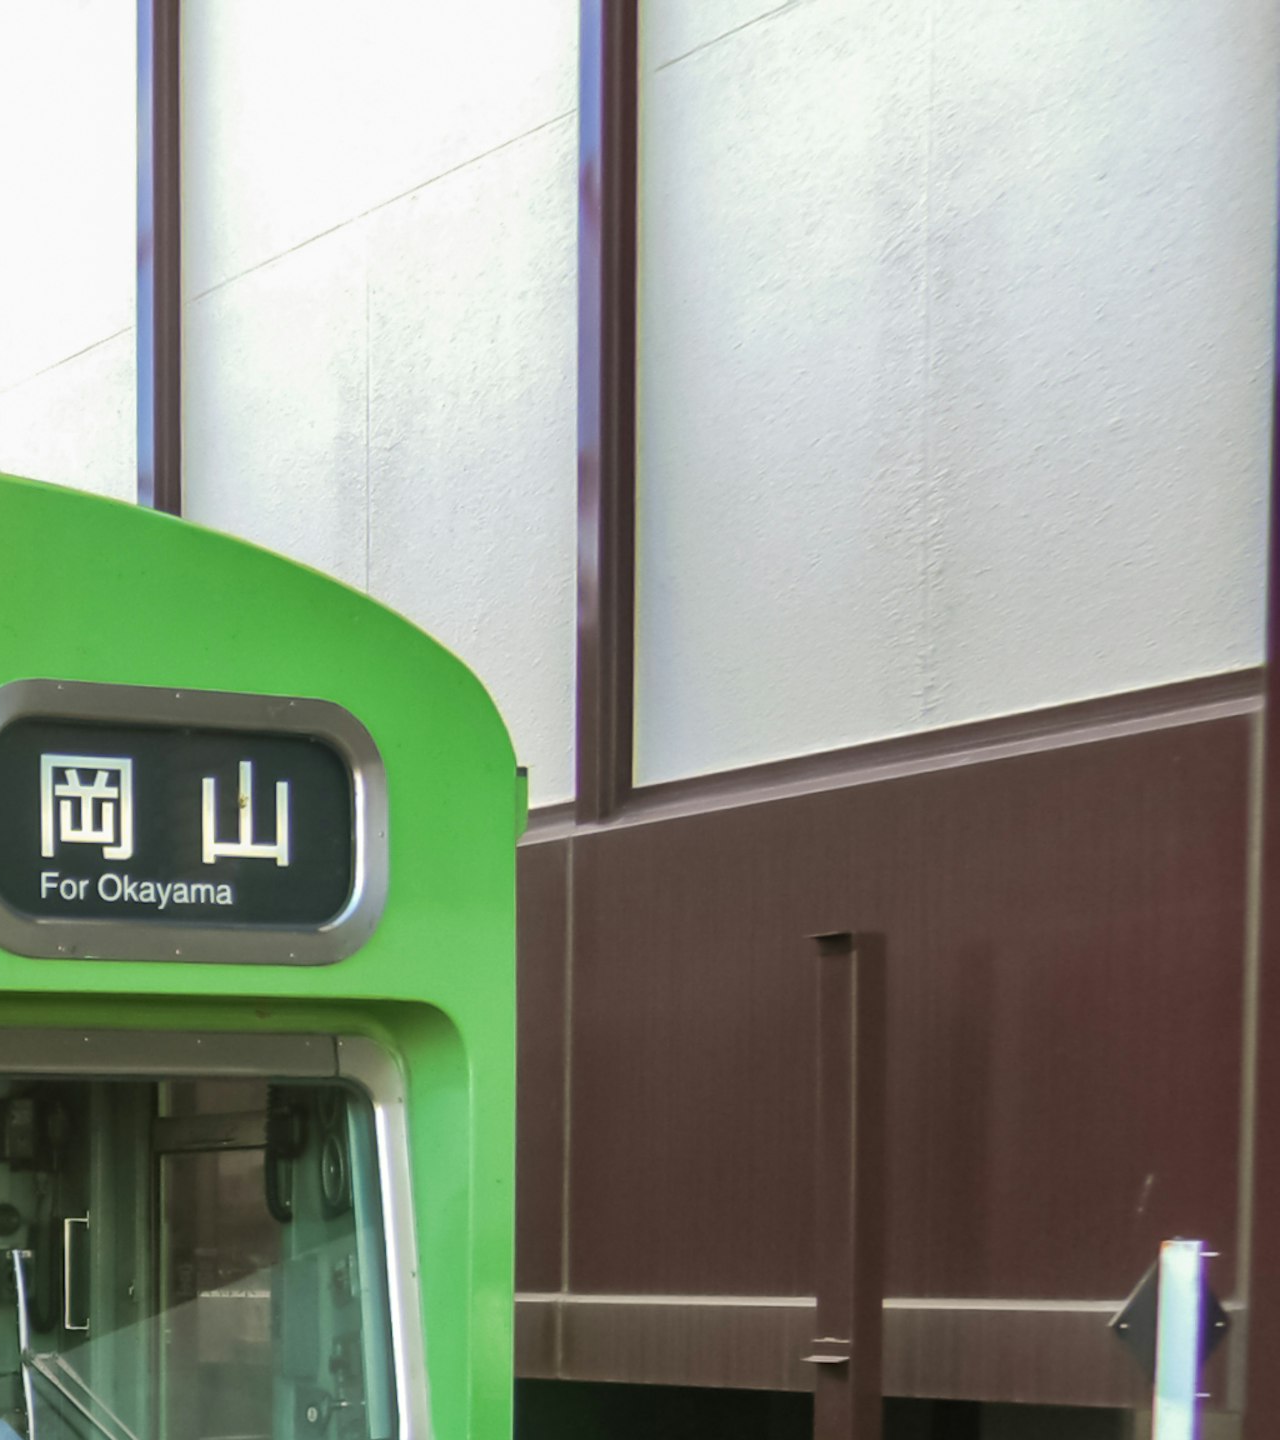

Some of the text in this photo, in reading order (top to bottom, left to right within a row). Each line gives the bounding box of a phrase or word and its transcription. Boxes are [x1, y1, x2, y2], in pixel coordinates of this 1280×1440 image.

[39, 753, 290, 868] 岡山
[40, 872, 234, 910] For Okayama
